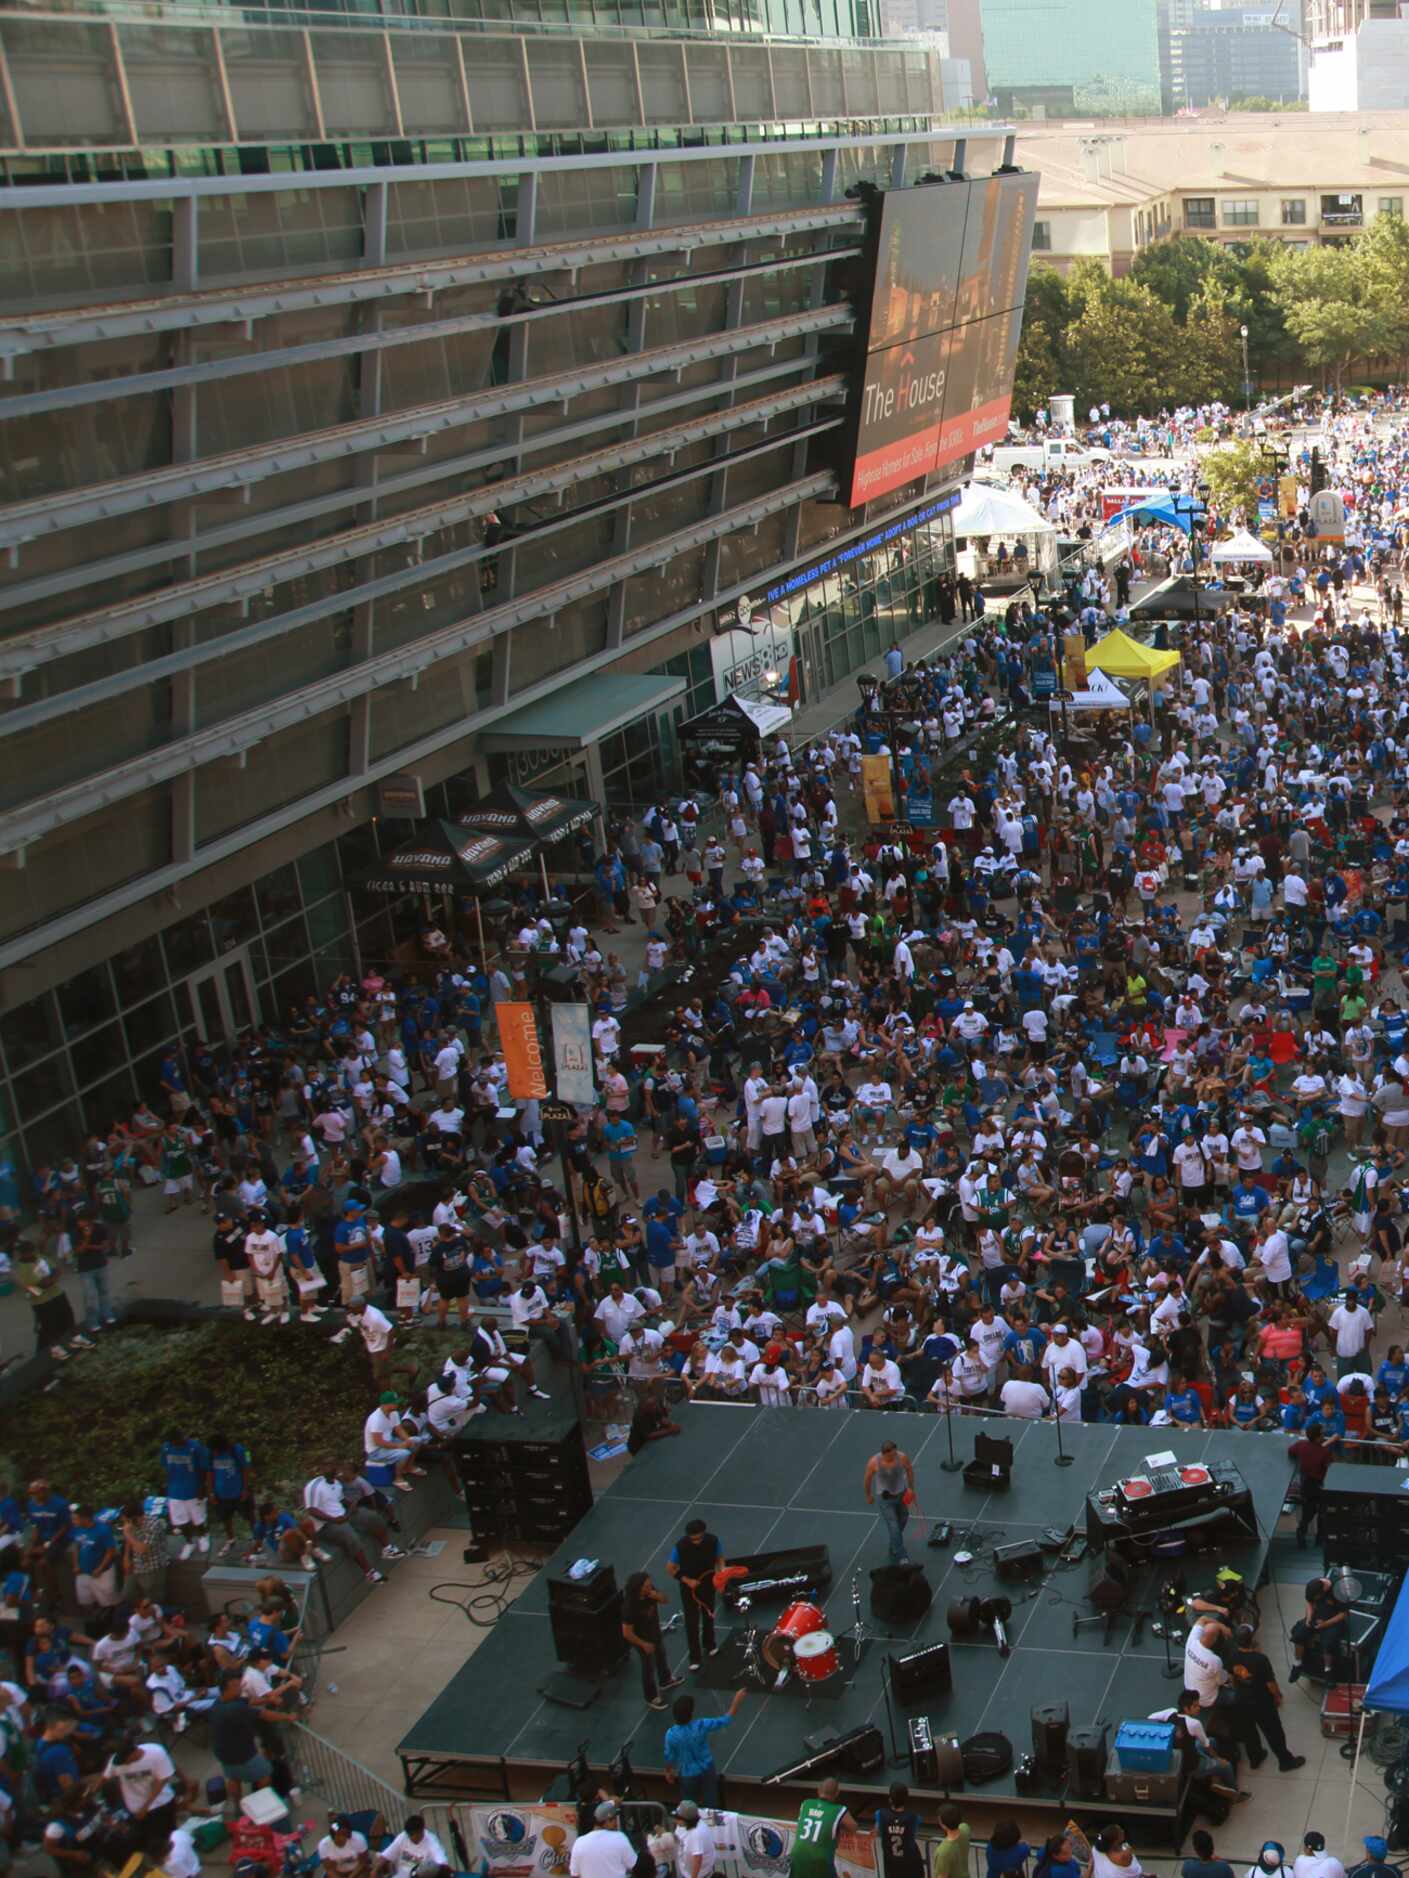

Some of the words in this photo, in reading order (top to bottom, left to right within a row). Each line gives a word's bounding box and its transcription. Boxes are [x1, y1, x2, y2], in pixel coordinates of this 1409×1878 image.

[865, 382, 894, 425] The
[896, 371, 946, 414] House
[785, 567, 820, 594] HOMELESS
[820, 559, 833, 575] PET
[885, 522, 902, 541] ADOPT
[724, 656, 761, 691] NEWS
[462, 813, 518, 824] HAVANA
[527, 799, 560, 820] HAVANA
[391, 854, 452, 865] HAVANA
[463, 836, 499, 862] HAVANA
[543, 1111, 573, 1121] PLAZA
[799, 1817, 823, 1843] 31
[891, 1835, 905, 1858] 2
